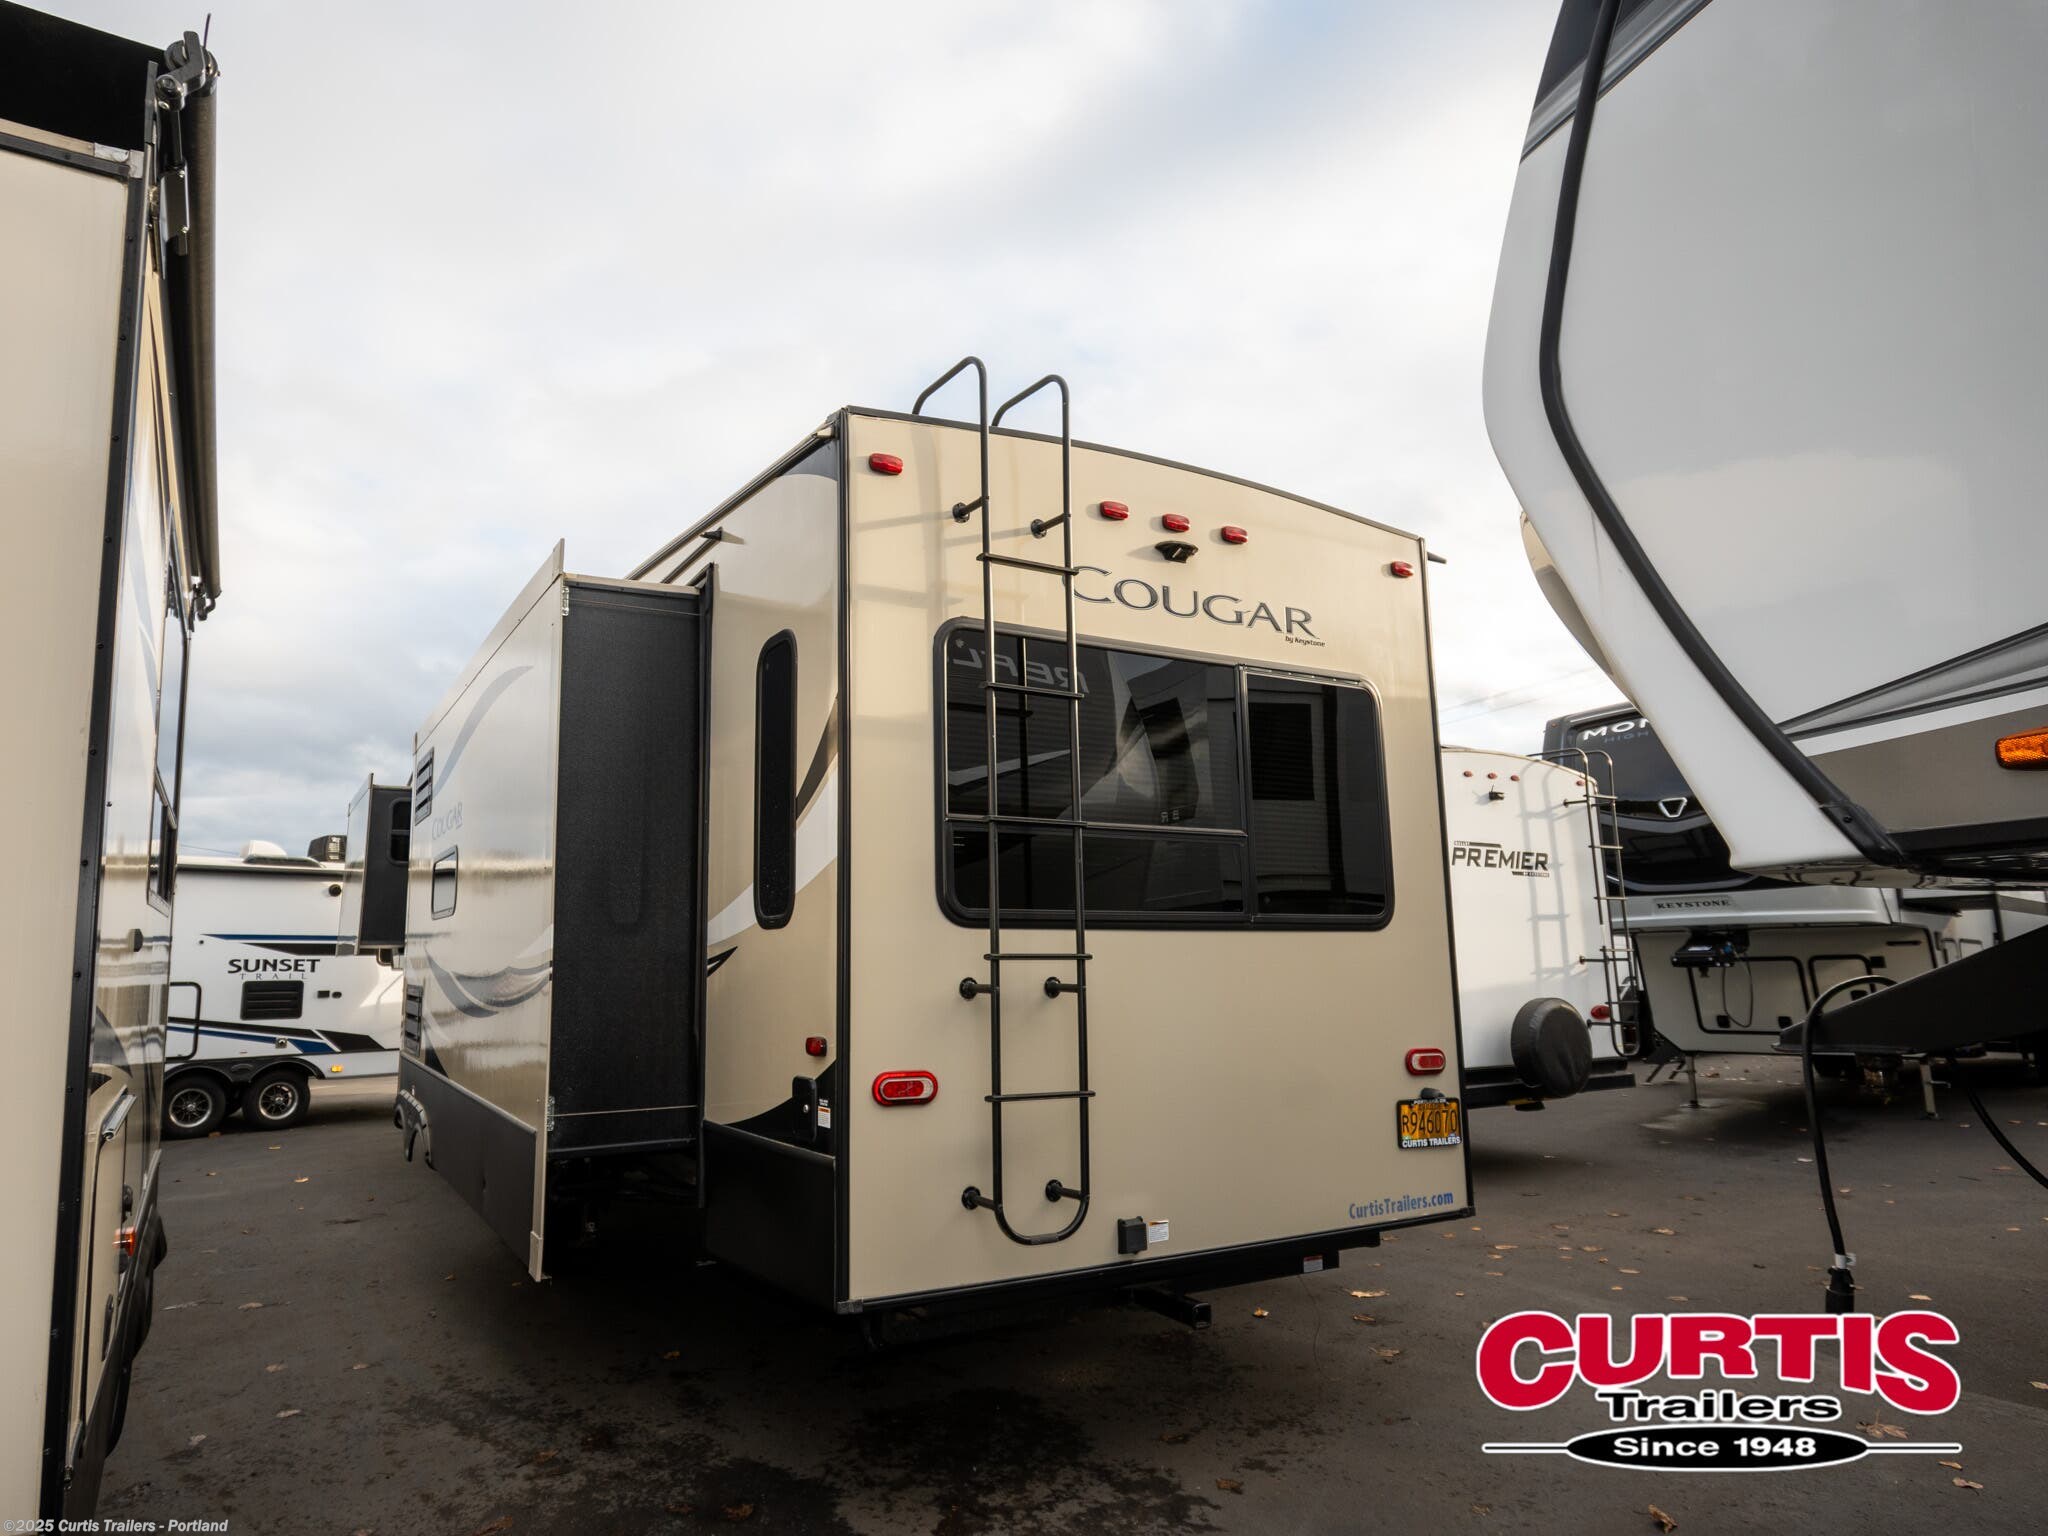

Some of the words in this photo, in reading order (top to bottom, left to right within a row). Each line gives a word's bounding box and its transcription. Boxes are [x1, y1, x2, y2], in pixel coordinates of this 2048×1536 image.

[1062, 565, 1320, 639] COUGAR
[432, 801, 463, 840] COUGAR
[1452, 847, 1549, 871] PREMIER
[1657, 900, 1731, 909] KEYSTONE
[227, 959, 321, 974] SUNSET
[1402, 1109, 1458, 1135] R946070
[1402, 1139, 1429, 1148] CURTIS
[1429, 1136, 1461, 1146] TRAILERS
[1348, 1192, 1454, 1219] CurtisTrailers.com
